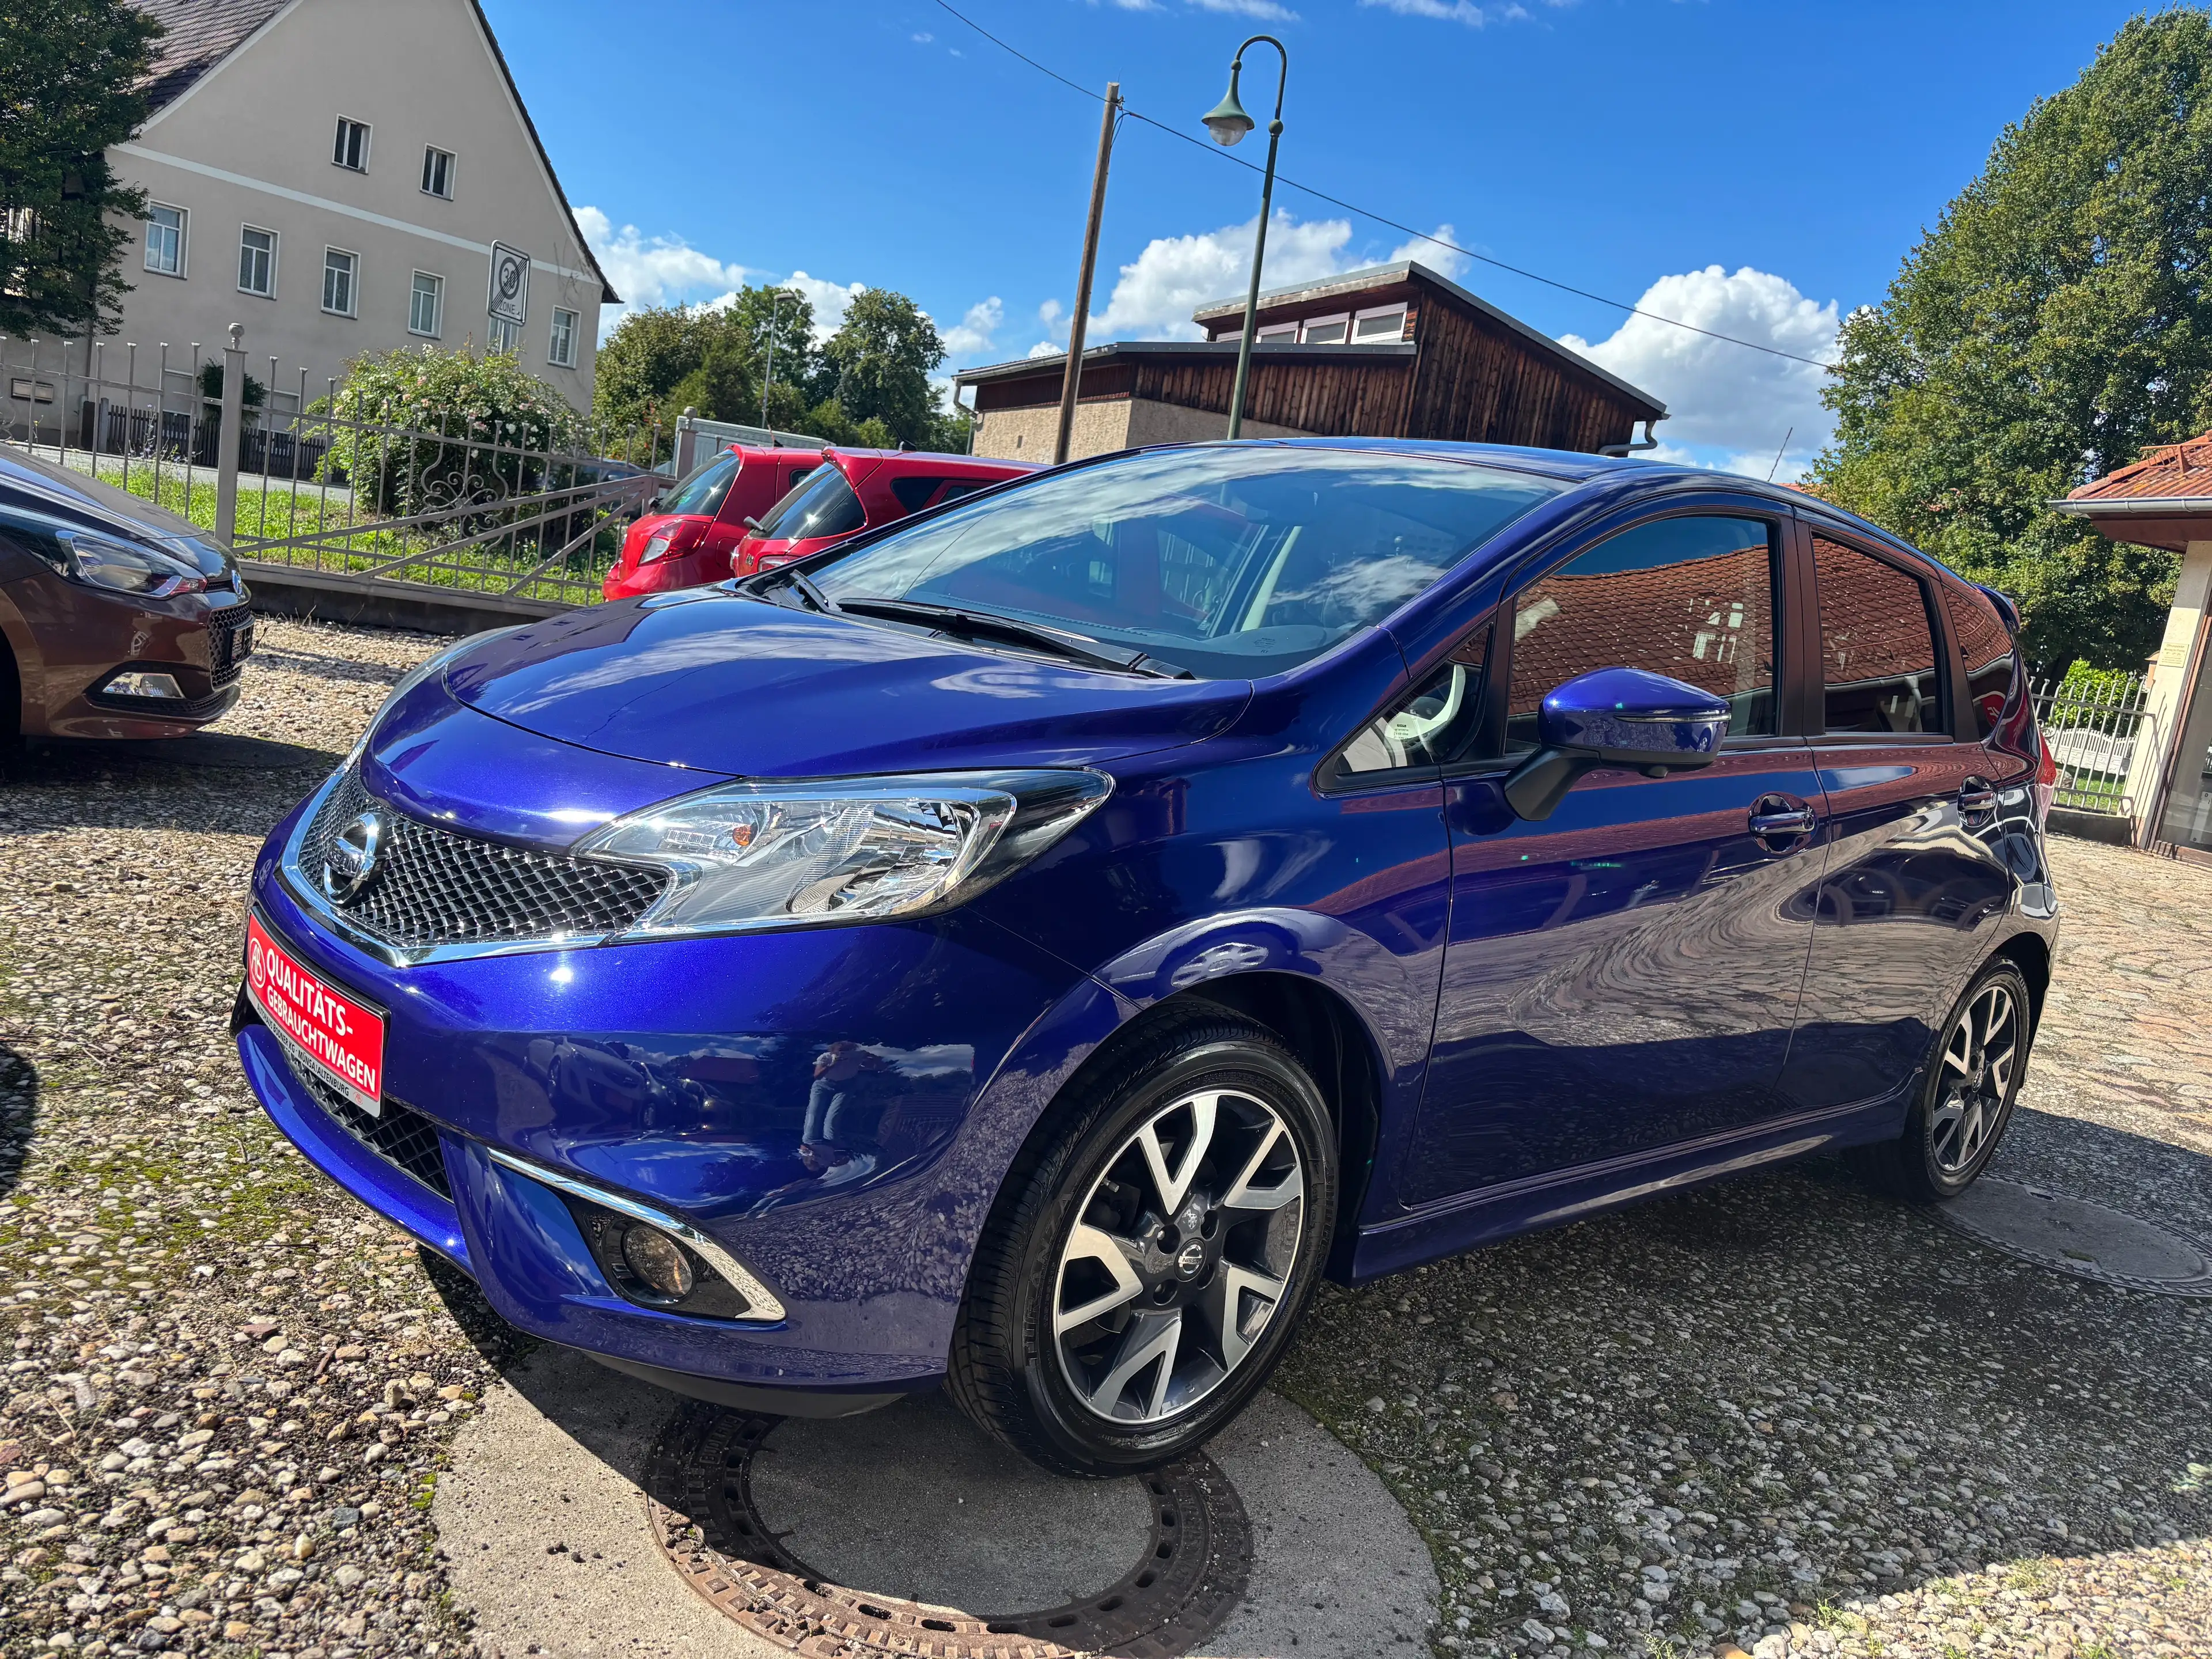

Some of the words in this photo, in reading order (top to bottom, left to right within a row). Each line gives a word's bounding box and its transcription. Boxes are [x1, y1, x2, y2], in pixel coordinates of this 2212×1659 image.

[503, 267, 515, 289] 30
[499, 301, 516, 315] ZONE
[267, 948, 353, 1036] QUALITÄTS-
[267, 985, 376, 1093] GEBRAUCHTWAGEN
[273, 1022, 289, 1047] BODNER
[289, 1041, 296, 1054] KG
